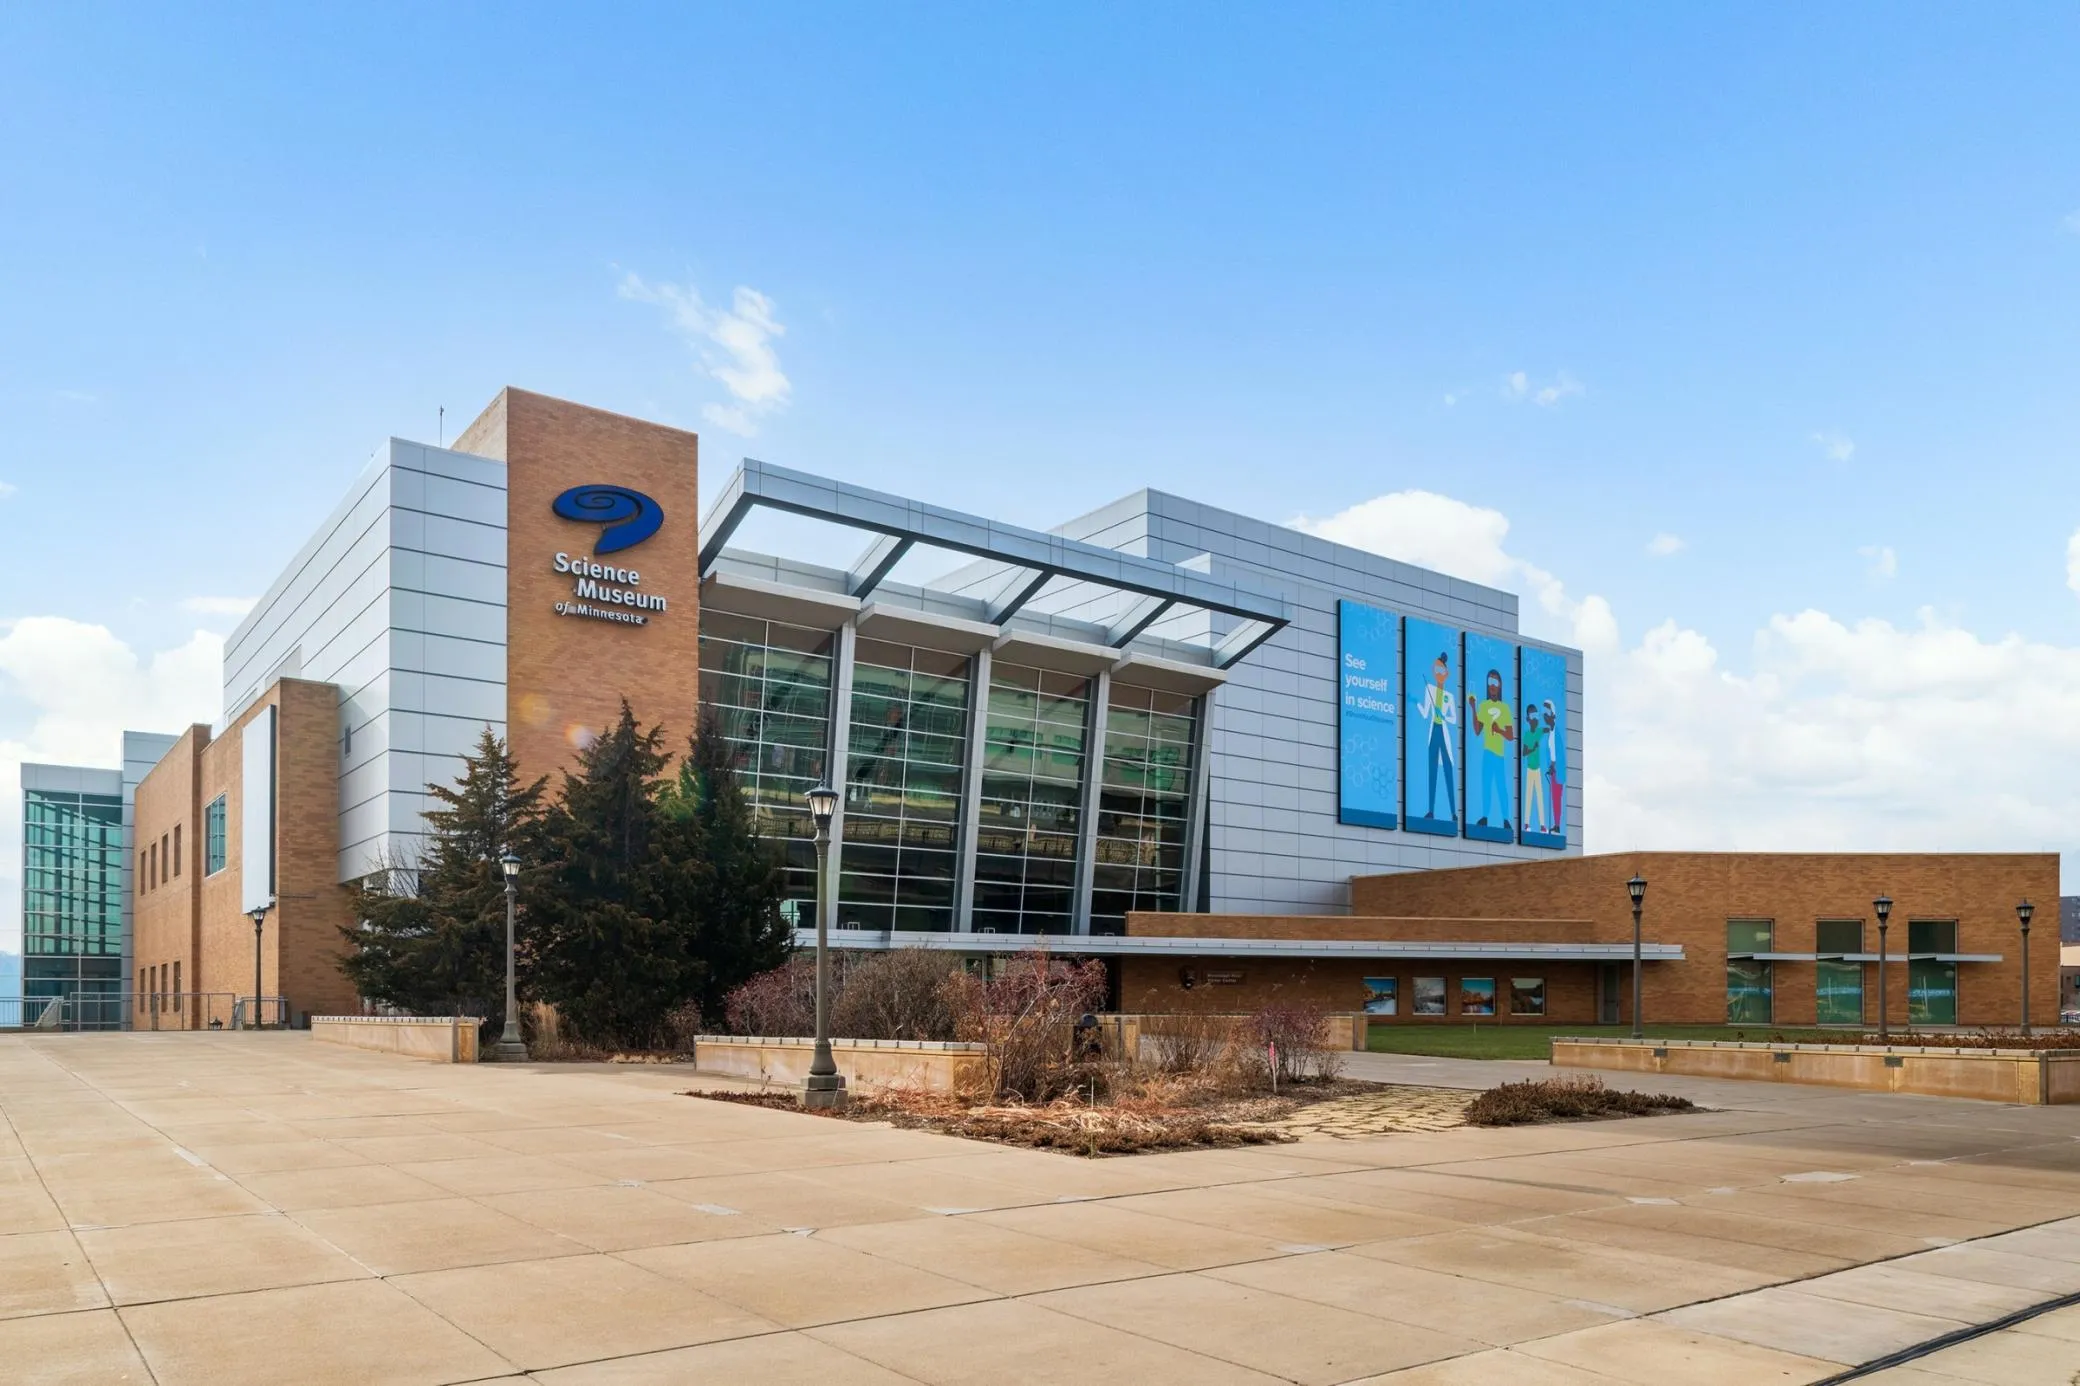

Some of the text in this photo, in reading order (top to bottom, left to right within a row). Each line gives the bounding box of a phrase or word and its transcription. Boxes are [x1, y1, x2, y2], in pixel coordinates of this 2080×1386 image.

[554, 552, 640, 585] Science
[577, 578, 667, 611] Museum
[555, 601, 645, 625] of Minnesota
[1345, 653, 1367, 670] See
[1345, 673, 1388, 692] yourself
[1345, 691, 1395, 714] in science
